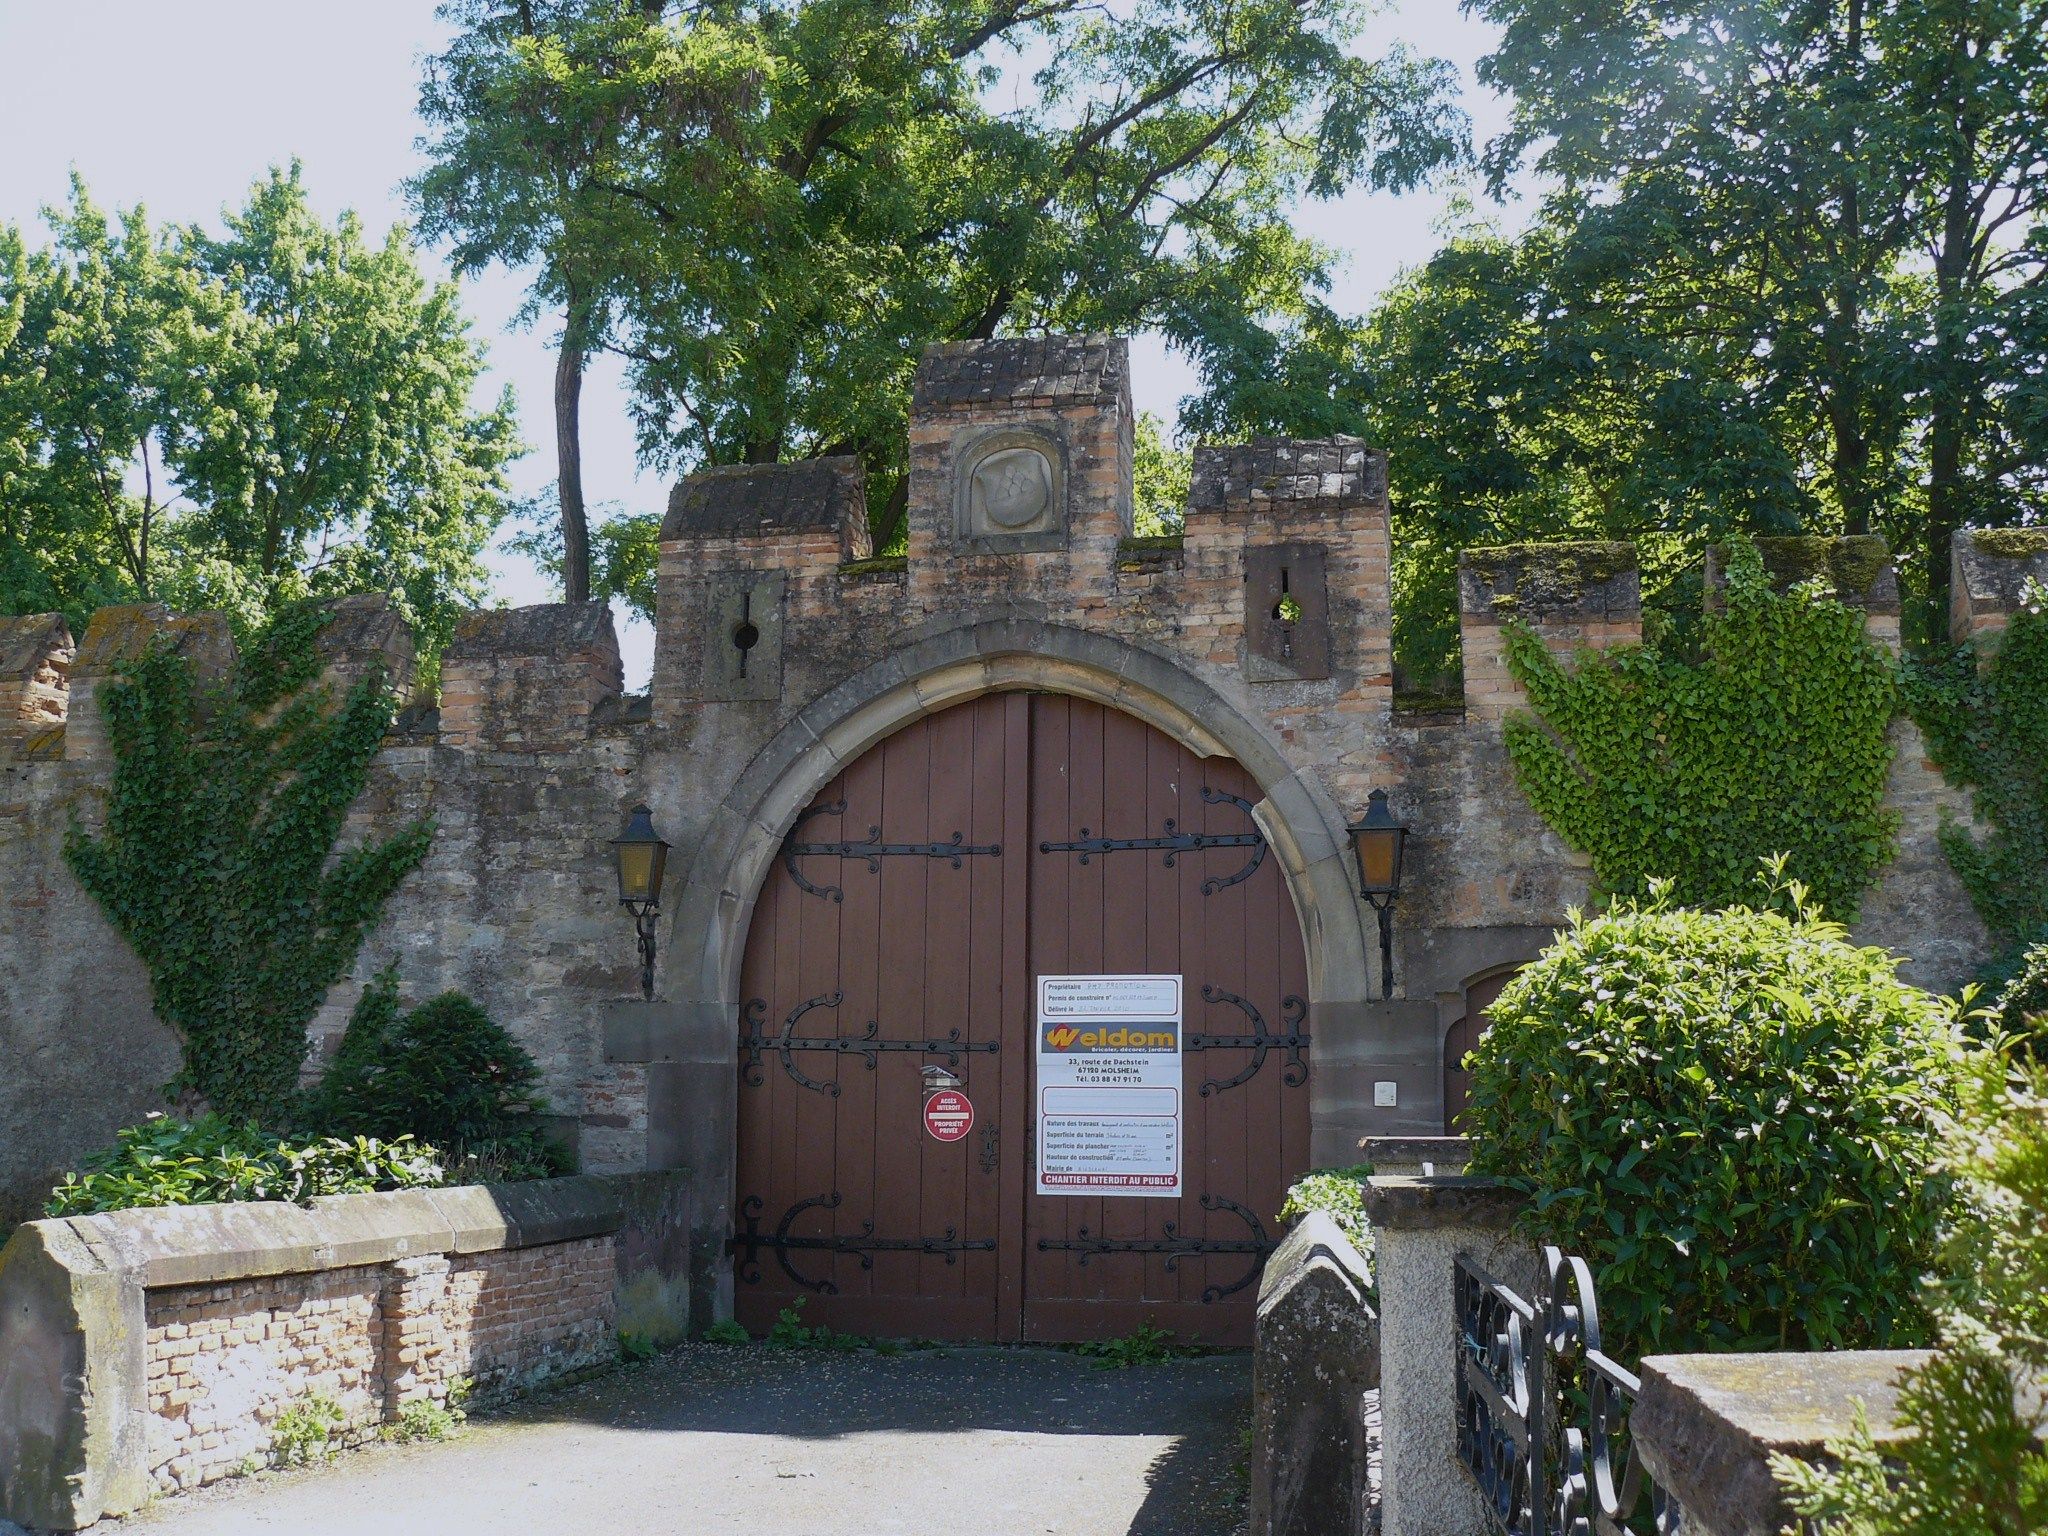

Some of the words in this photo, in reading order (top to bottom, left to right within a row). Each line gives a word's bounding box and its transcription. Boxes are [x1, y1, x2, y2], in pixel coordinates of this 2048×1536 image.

[1048, 983, 1081, 991] Propriétaire
[1046, 1027, 1174, 1047] Weldom
[1085, 1142, 1109, 1150] plancher
[1045, 1175, 1088, 1184] CHANTIER
[1090, 1176, 1128, 1185] INTERDIT
[1129, 1177, 1140, 1185] AU
[1143, 1177, 1174, 1186] PUBLIC
